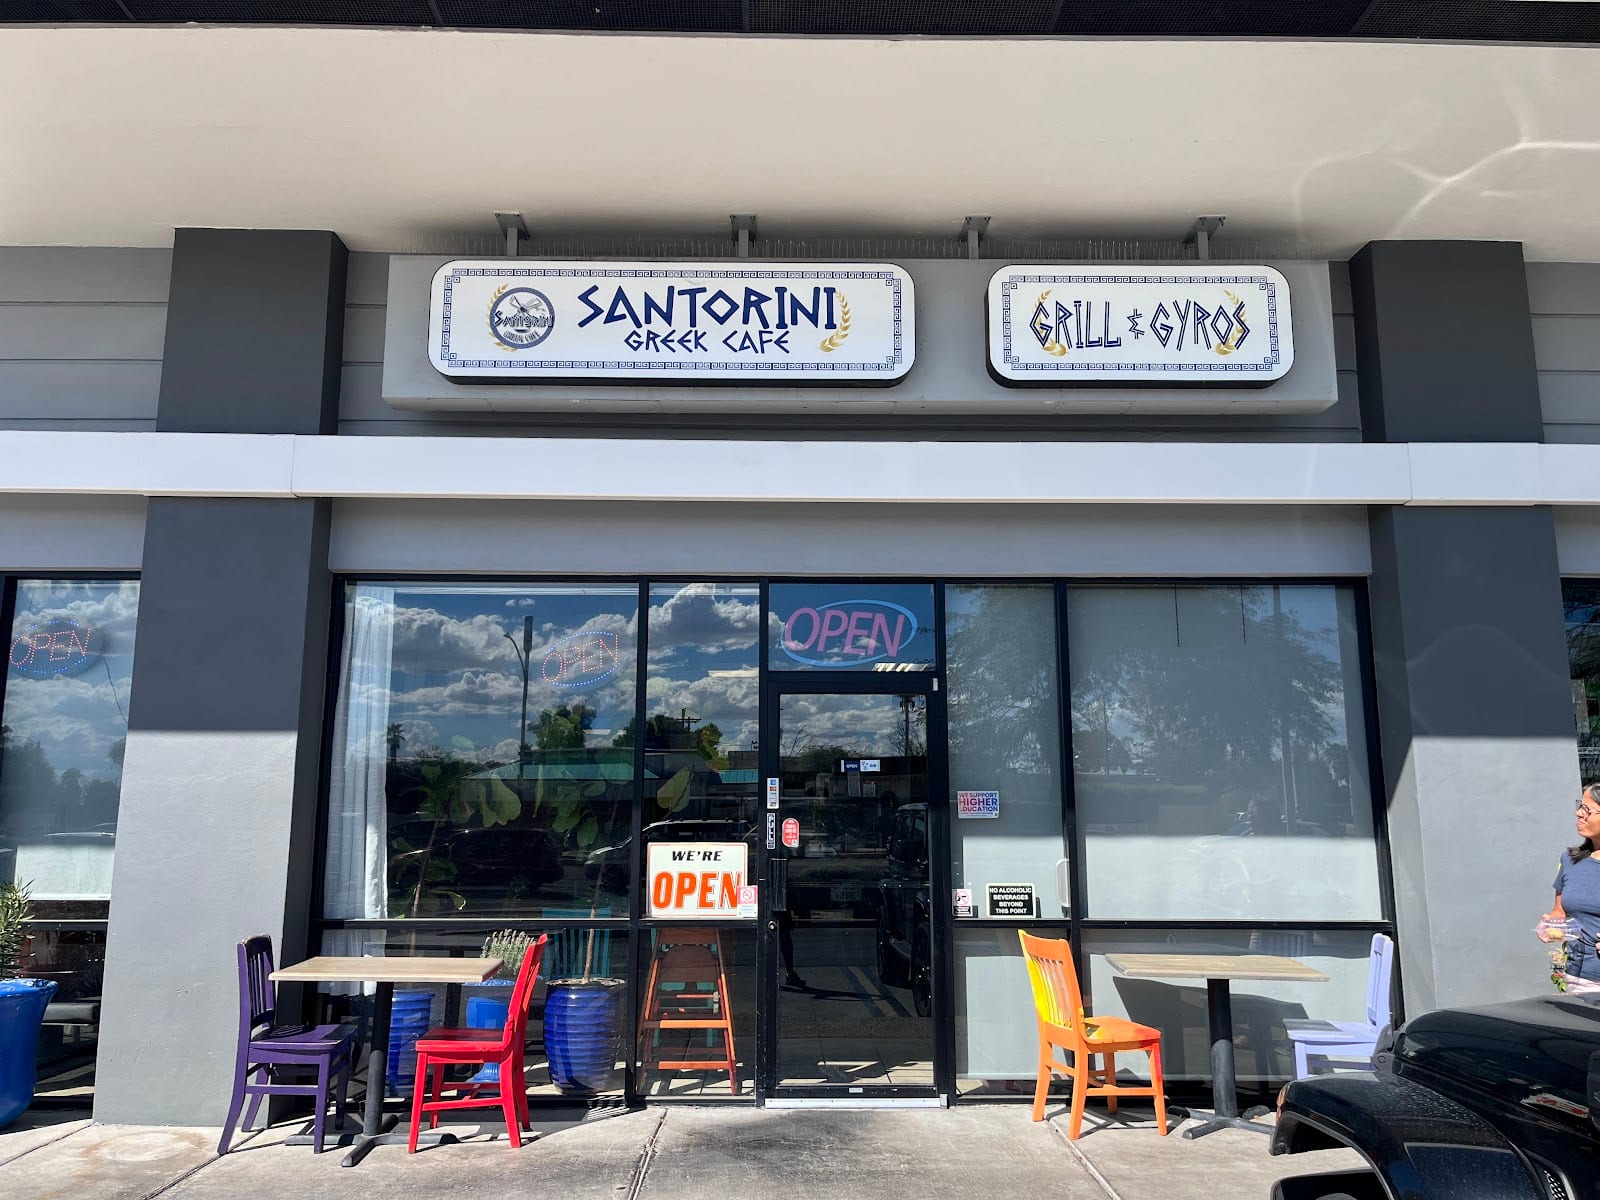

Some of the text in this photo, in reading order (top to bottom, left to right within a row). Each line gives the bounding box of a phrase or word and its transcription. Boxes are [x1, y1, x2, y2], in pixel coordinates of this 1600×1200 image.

[577, 284, 837, 329] SANTORINI
[1029, 299, 1250, 351] GRILL & GYROS
[623, 329, 790, 354] GREEK CAFE
[9, 627, 91, 666] OPEN
[784, 607, 905, 657] OPEN
[542, 634, 618, 682] OPEN
[959, 798, 998, 806] HIGHER
[672, 850, 724, 862] WE'RE
[652, 870, 742, 909] OPEN
